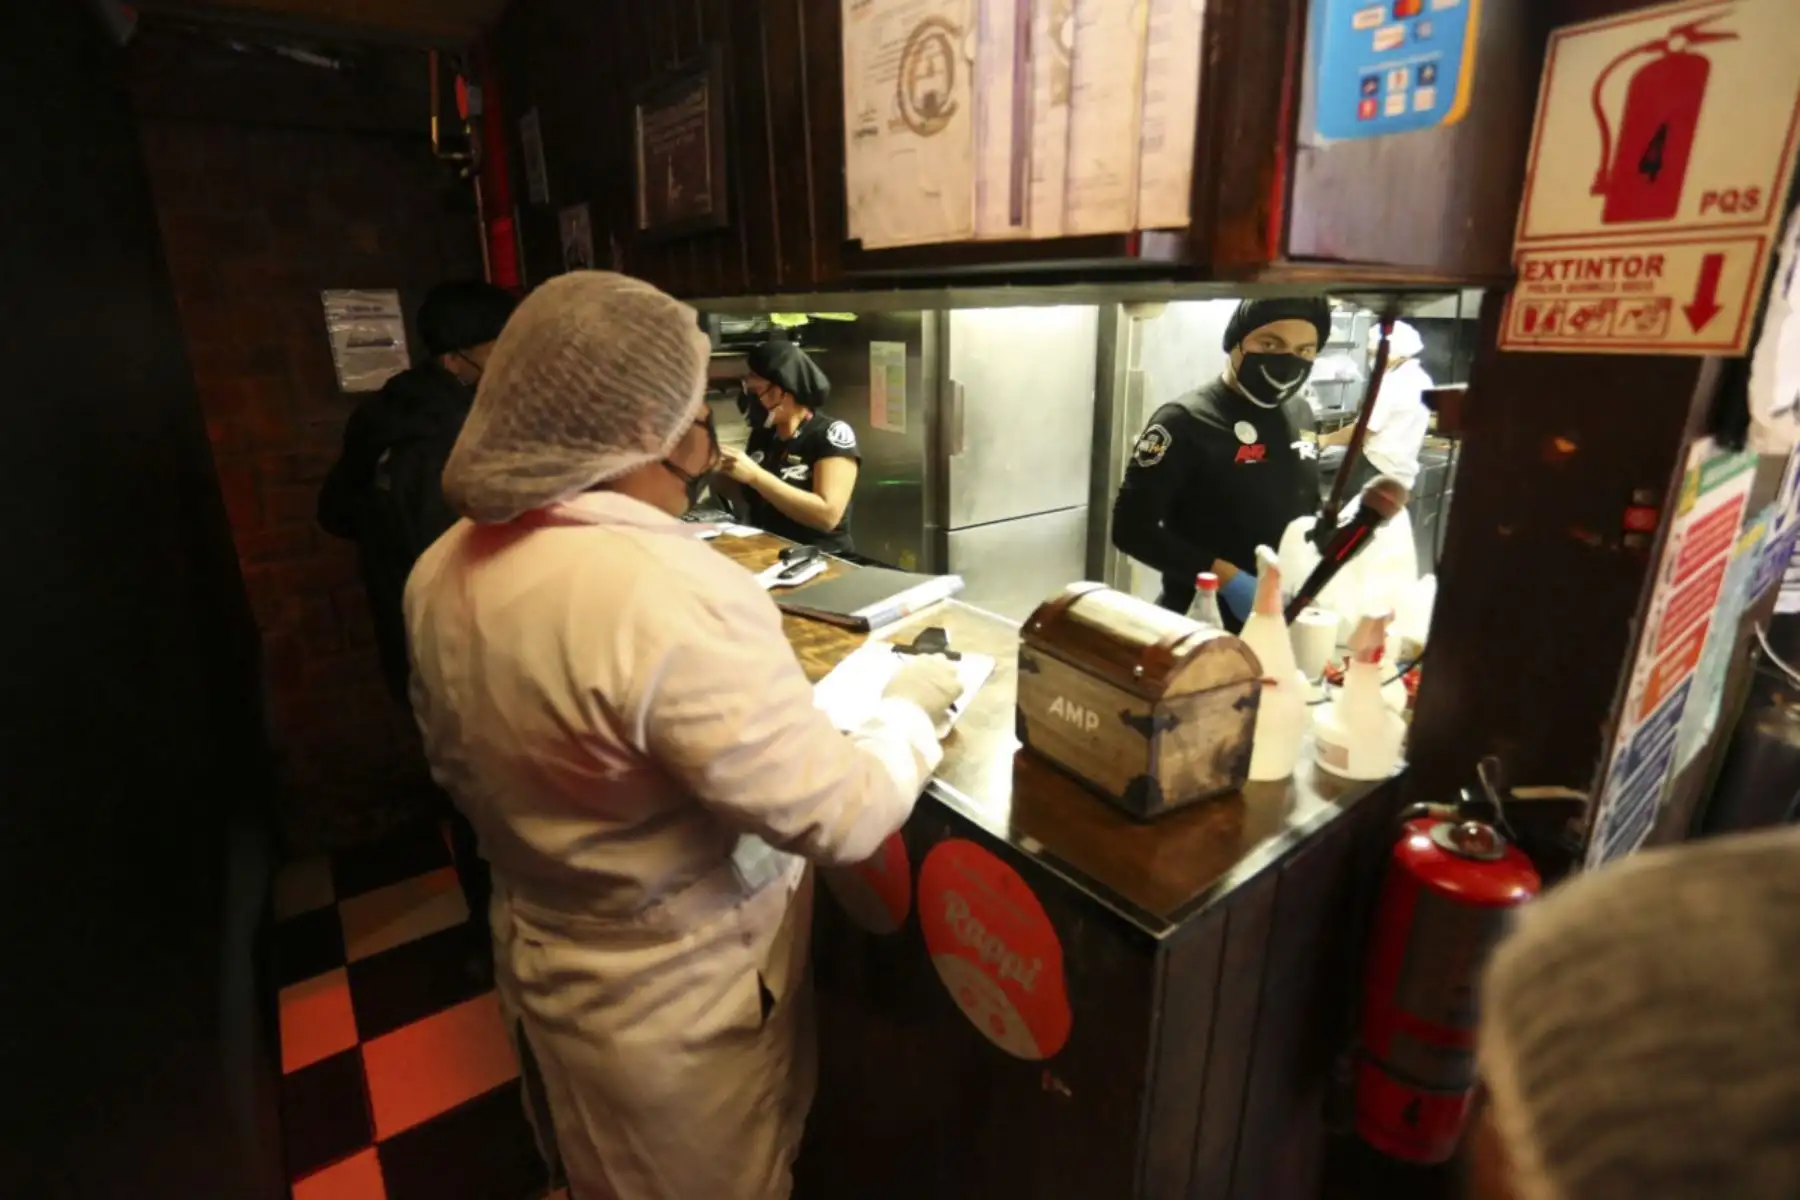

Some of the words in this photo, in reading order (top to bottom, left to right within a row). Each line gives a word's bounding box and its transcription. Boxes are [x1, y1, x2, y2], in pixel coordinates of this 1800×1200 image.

[1638, 123, 1669, 184] 4
[1700, 188, 1761, 215] PQS
[1524, 255, 1664, 282] EXTINTOR
[1048, 694, 1100, 733] AMP
